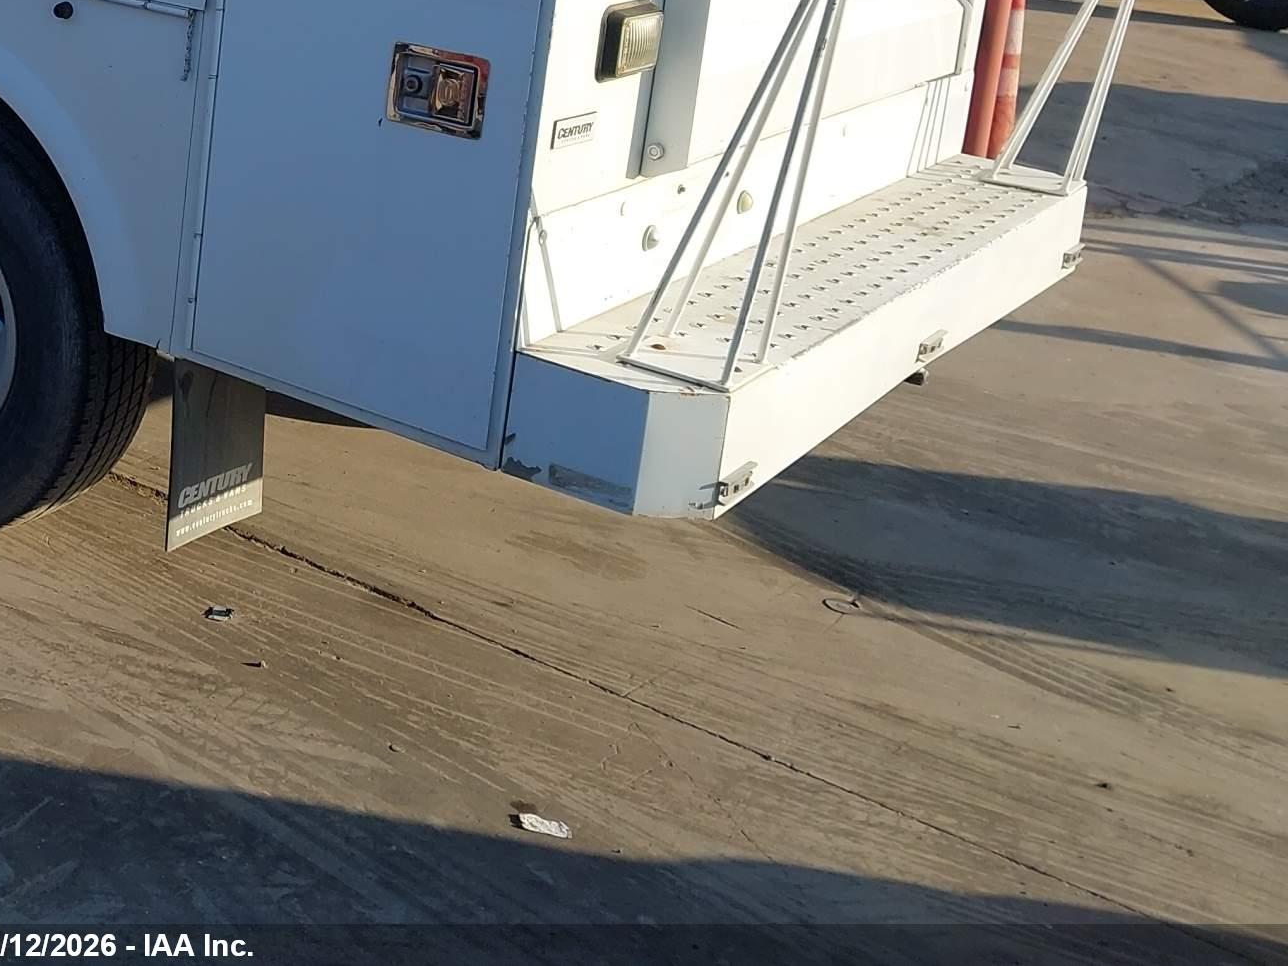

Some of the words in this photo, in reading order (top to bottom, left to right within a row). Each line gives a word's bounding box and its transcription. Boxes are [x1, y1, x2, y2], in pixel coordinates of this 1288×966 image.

[557, 121, 595, 140] CENTURY
[177, 462, 253, 509] CENTURY
[180, 498, 213, 519] TRUCKS
[223, 484, 248, 500] VANS
